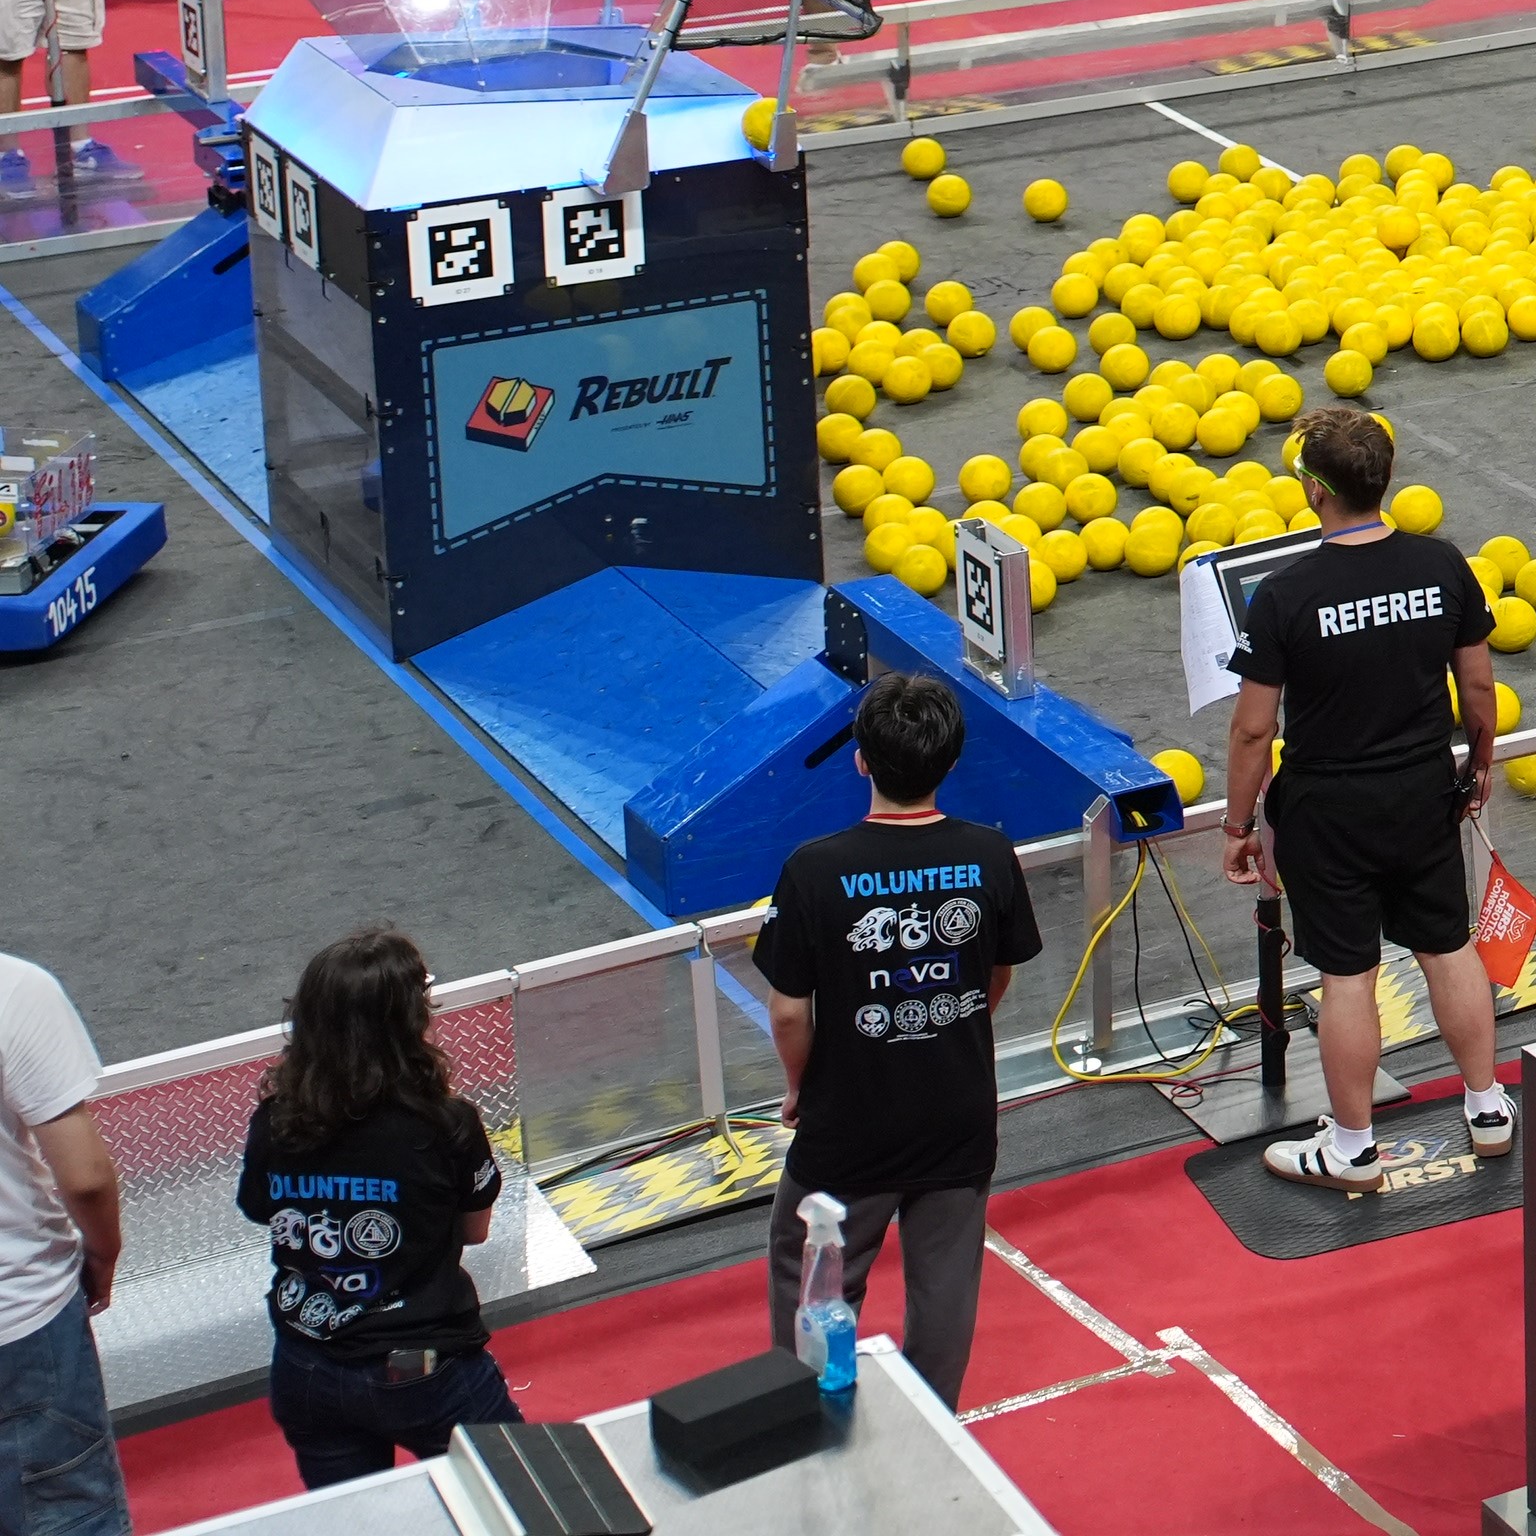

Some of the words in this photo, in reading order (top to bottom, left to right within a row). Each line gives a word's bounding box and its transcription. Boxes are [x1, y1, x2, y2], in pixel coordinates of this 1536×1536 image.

[569, 356, 732, 422] REBUILT
[48, 566, 98, 638] 10415
[1318, 585, 1443, 638] REFEREE
[840, 863, 982, 899] VOLUNTEER
[1481, 887, 1511, 945] ROBOTICS
[1496, 902, 1516, 942] FIRST
